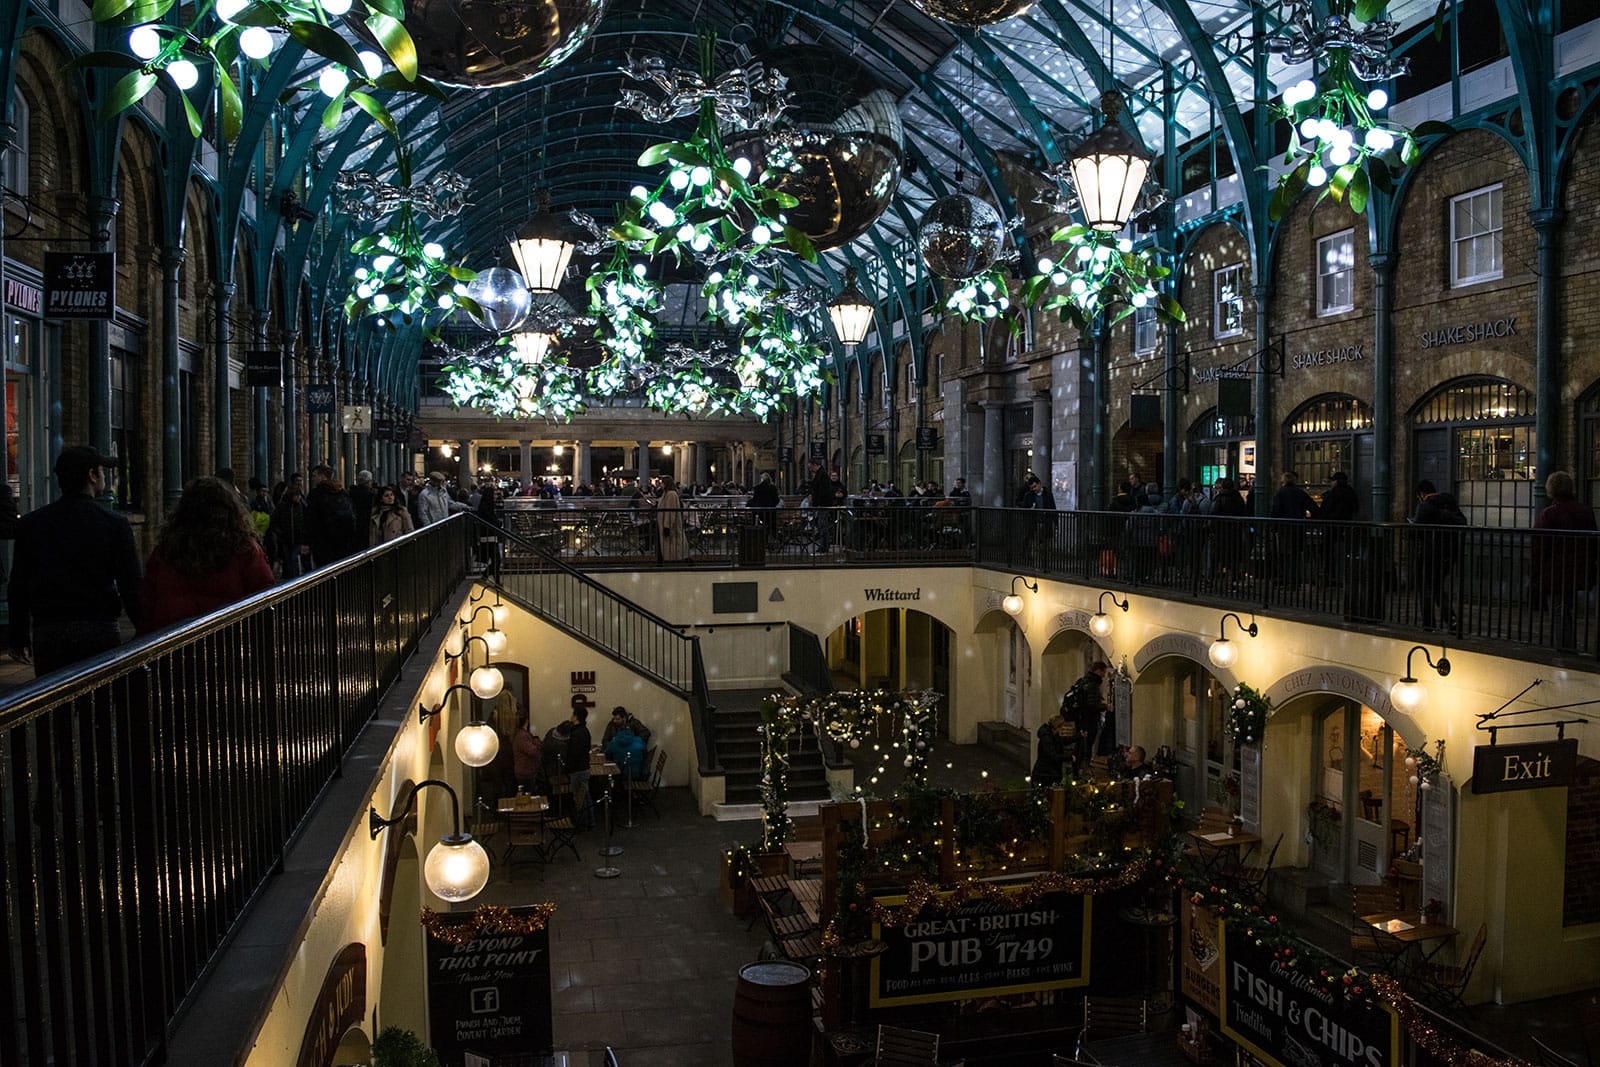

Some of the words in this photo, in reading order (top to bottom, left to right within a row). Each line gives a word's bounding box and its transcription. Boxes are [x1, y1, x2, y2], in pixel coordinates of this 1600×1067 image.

[7, 279, 41, 313] PYLONES
[50, 289, 108, 307] PYLONES
[1421, 326, 1463, 349] SHAKE
[1466, 318, 1516, 342] SHACK
[1292, 352, 1325, 369] SHAKE
[1326, 345, 1364, 364] SHACK
[1195, 367, 1220, 384] SHAKE
[865, 588, 920, 602] Whittard
[1285, 672, 1312, 692] CHEZ
[1502, 752, 1551, 782] Exit
[903, 918, 970, 938] GREAT
[979, 909, 1056, 932] BRITISH
[439, 953, 480, 970] THIS
[482, 949, 542, 968] POINT
[910, 937, 983, 973] PUB
[994, 937, 1054, 964] 1749
[886, 978, 909, 993] FOOD
[958, 971, 980, 984] ALES
[1232, 960, 1283, 1017] FISH
[1288, 1000, 1301, 1025] &
[1303, 1006, 1383, 1067] CHIPS
